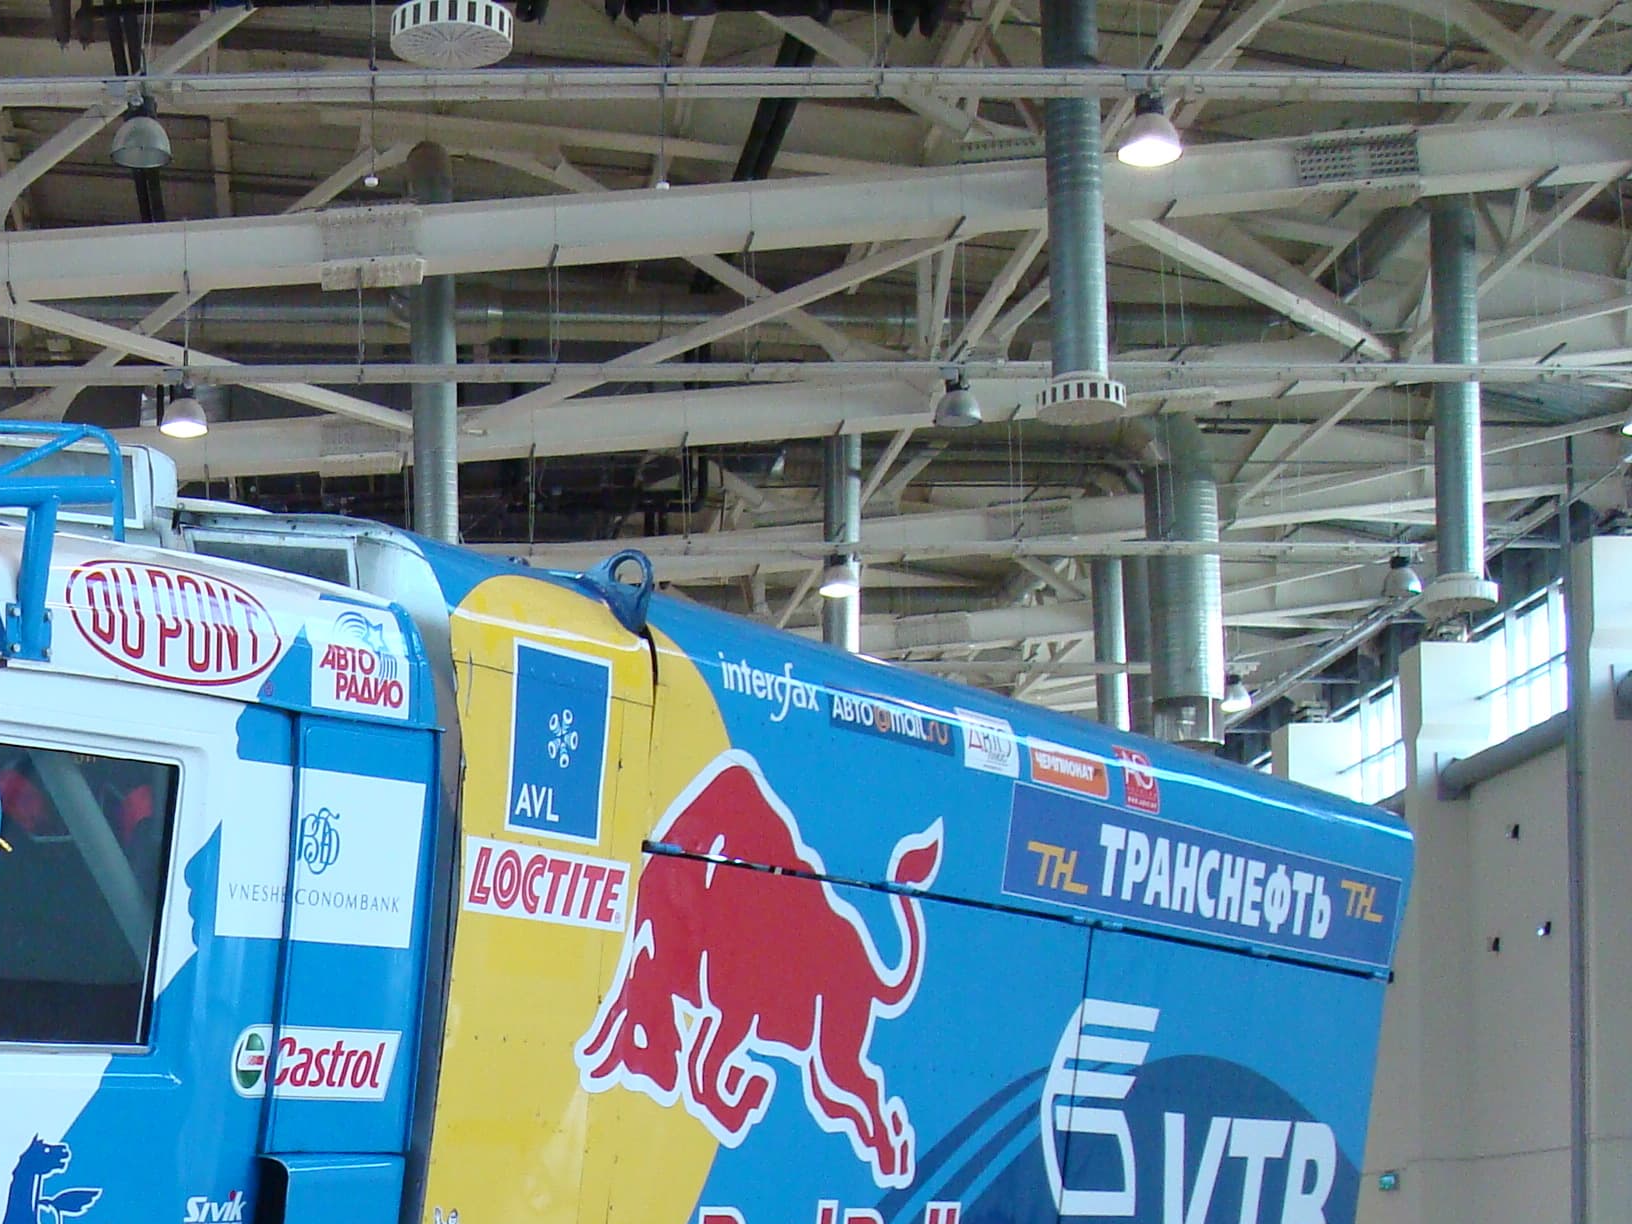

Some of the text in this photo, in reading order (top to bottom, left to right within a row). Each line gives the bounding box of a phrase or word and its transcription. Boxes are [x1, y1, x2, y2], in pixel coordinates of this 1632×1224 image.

[334, 673, 405, 709] РАДИО
[718, 651, 820, 722] interfax
[513, 782, 560, 823] AVL
[467, 845, 627, 924] LOCTITE
[1099, 823, 1333, 941] ТРАНСНЕФТЬ
[264, 1035, 387, 1090] Castrol
